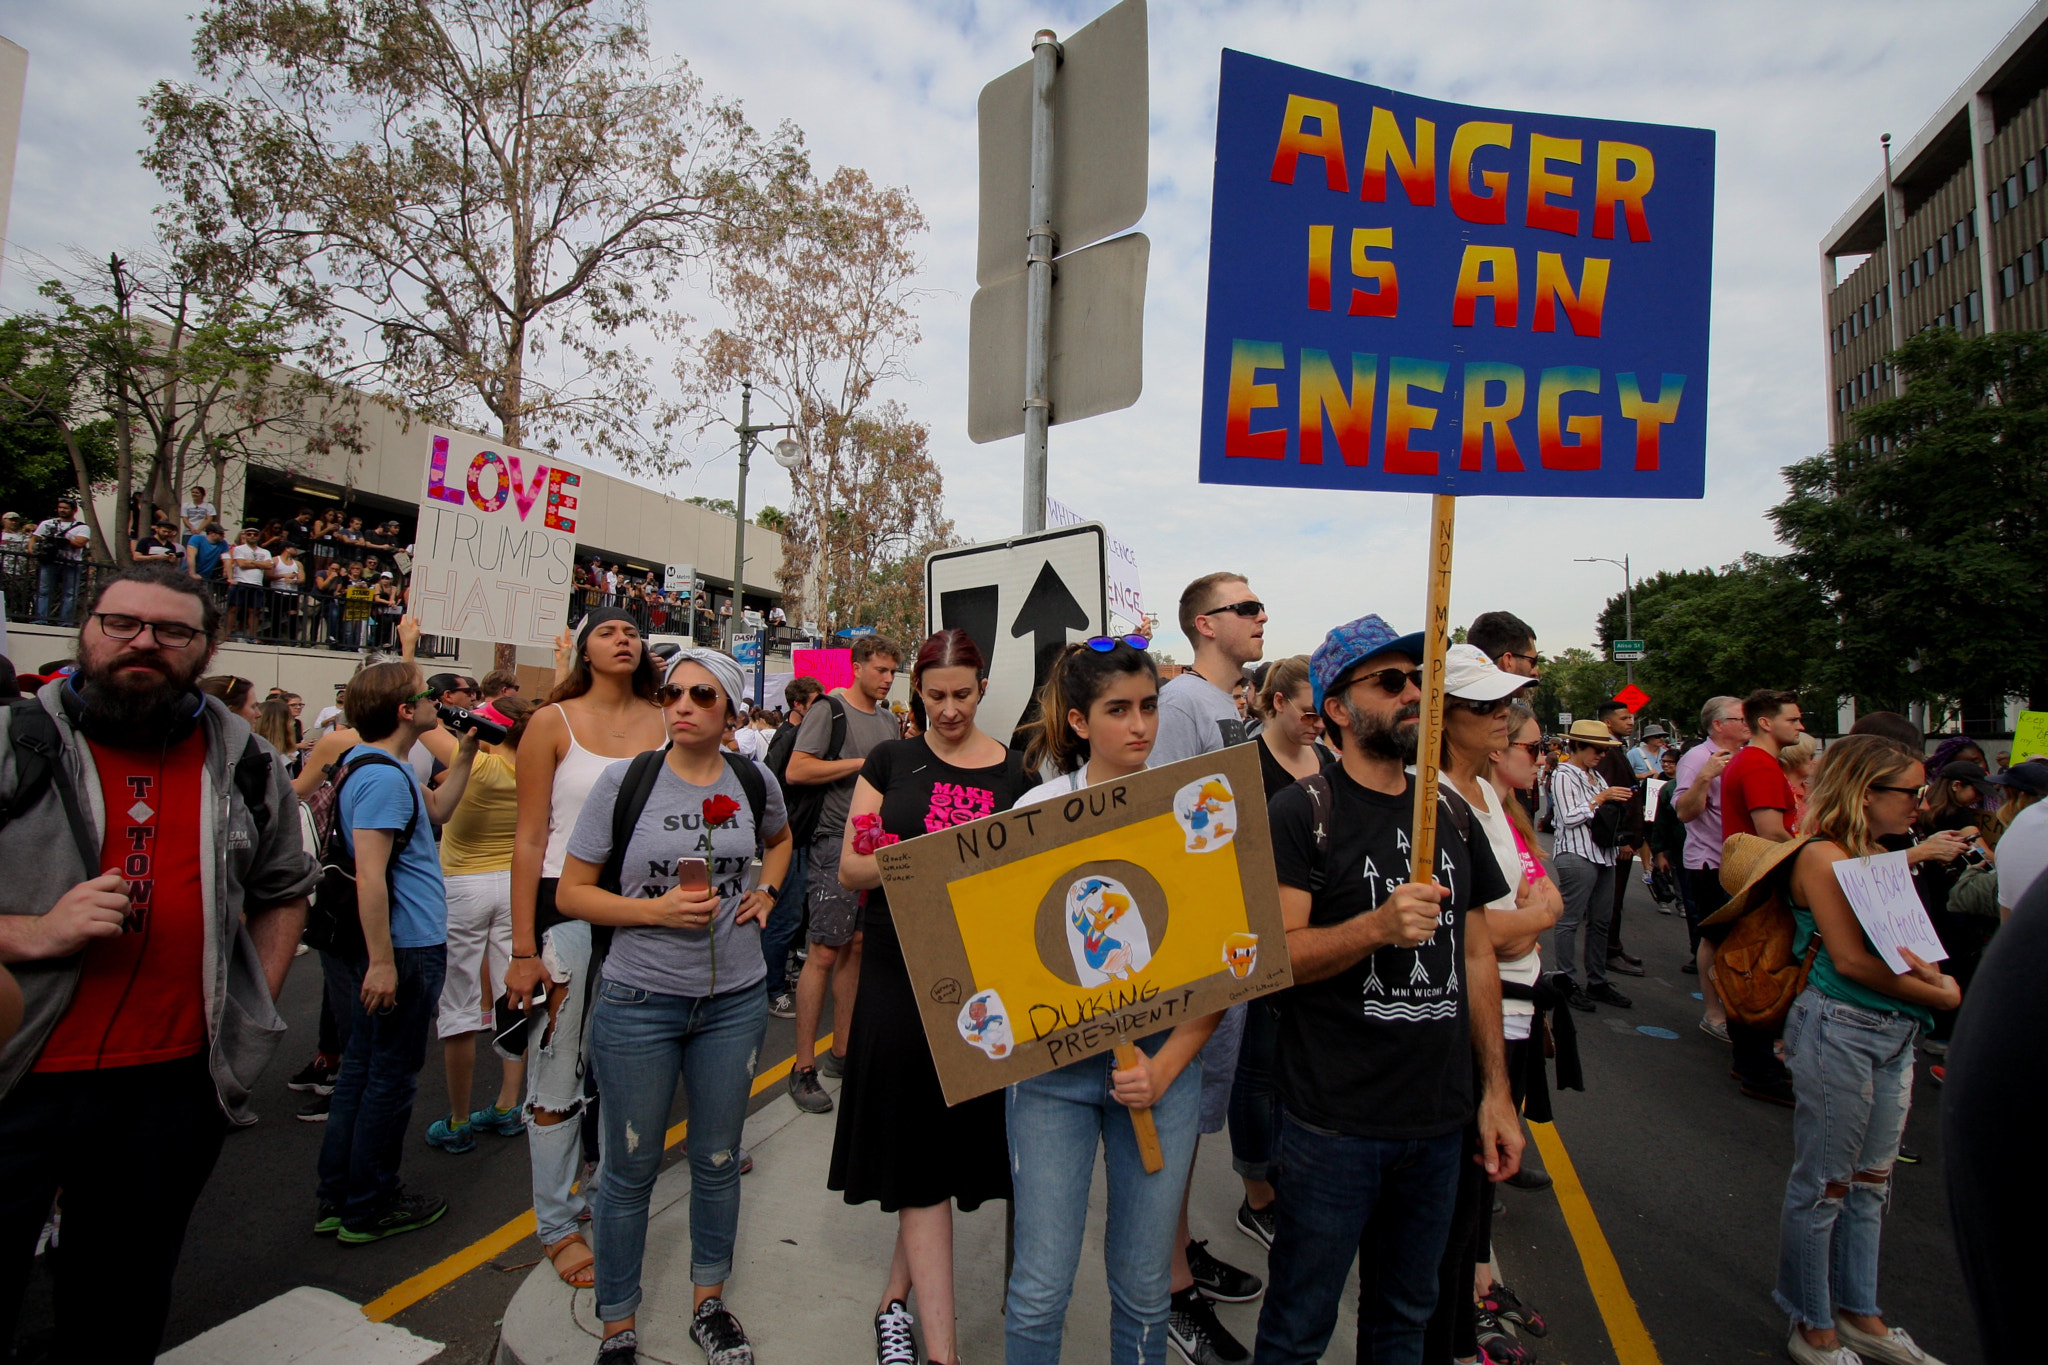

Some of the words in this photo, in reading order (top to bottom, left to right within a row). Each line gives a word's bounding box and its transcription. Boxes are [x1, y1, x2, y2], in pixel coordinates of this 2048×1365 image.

[1269, 93, 1655, 243] ANGER
[1307, 224, 1398, 318] IS
[1452, 244, 1611, 339] AN
[1225, 338, 1687, 476] ENERGY
[427, 434, 581, 534] LOVE
[425, 505, 572, 585] TRUMPS
[1107, 535, 1138, 568] LENCE
[1438, 518, 1452, 588] NOT
[412, 565, 565, 644] HATE
[1435, 604, 1448, 643] MY
[1422, 659, 1443, 848] PRESIDENT
[930, 793, 995, 814] OUT
[932, 781, 995, 802] MAKE
[693, 834, 716, 851] A
[957, 808, 1042, 864] NOT
[1063, 786, 1127, 823] OUR
[641, 877, 743, 899] WAN
[648, 856, 750, 878] NTY
[1842, 869, 1872, 914] MY
[1028, 979, 1160, 1042] DUCKING
[1391, 987, 1410, 997] MNI
[1046, 989, 1195, 1066] PRESIDENT!
